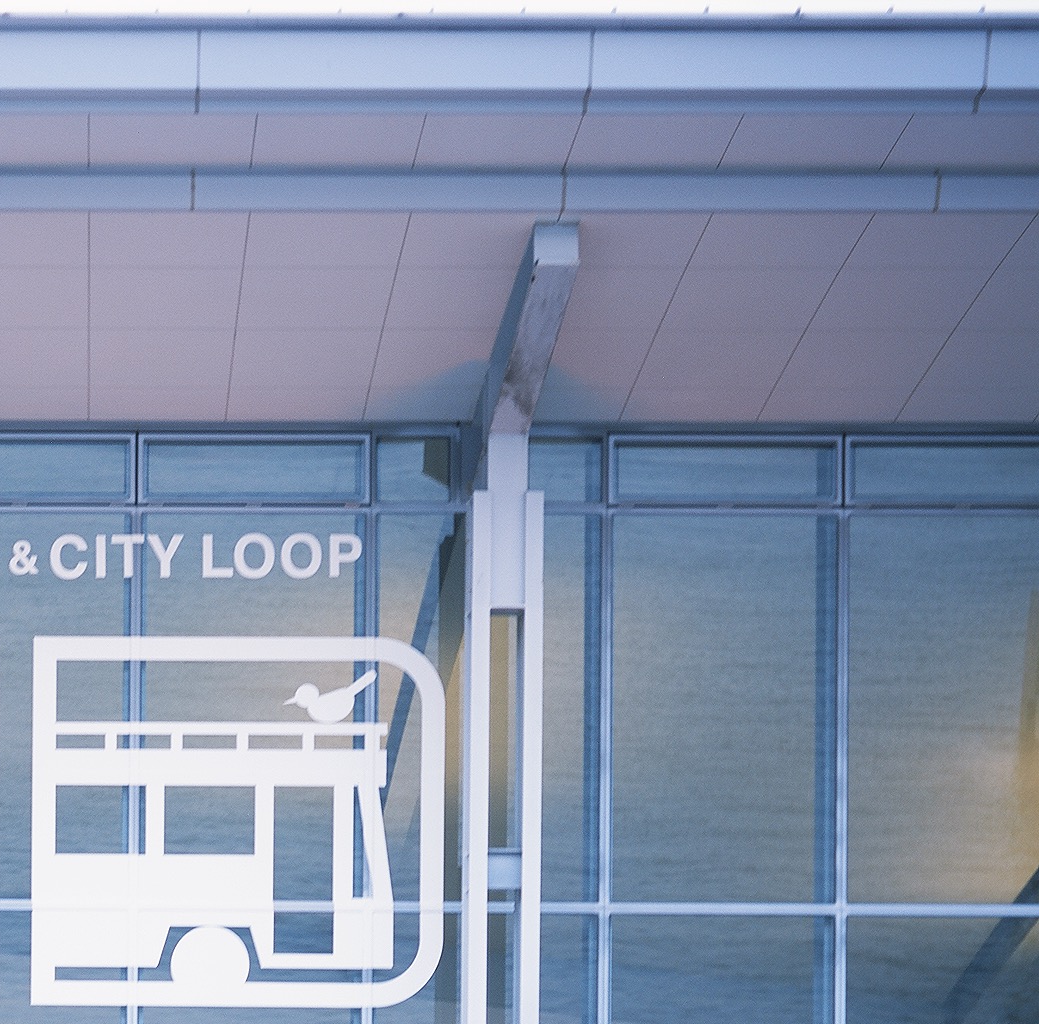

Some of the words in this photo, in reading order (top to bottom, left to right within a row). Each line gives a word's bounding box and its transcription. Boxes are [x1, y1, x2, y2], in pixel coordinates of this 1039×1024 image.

[9, 540, 38, 577] &
[49, 533, 183, 580] CITY
[202, 533, 363, 580] LOOP
